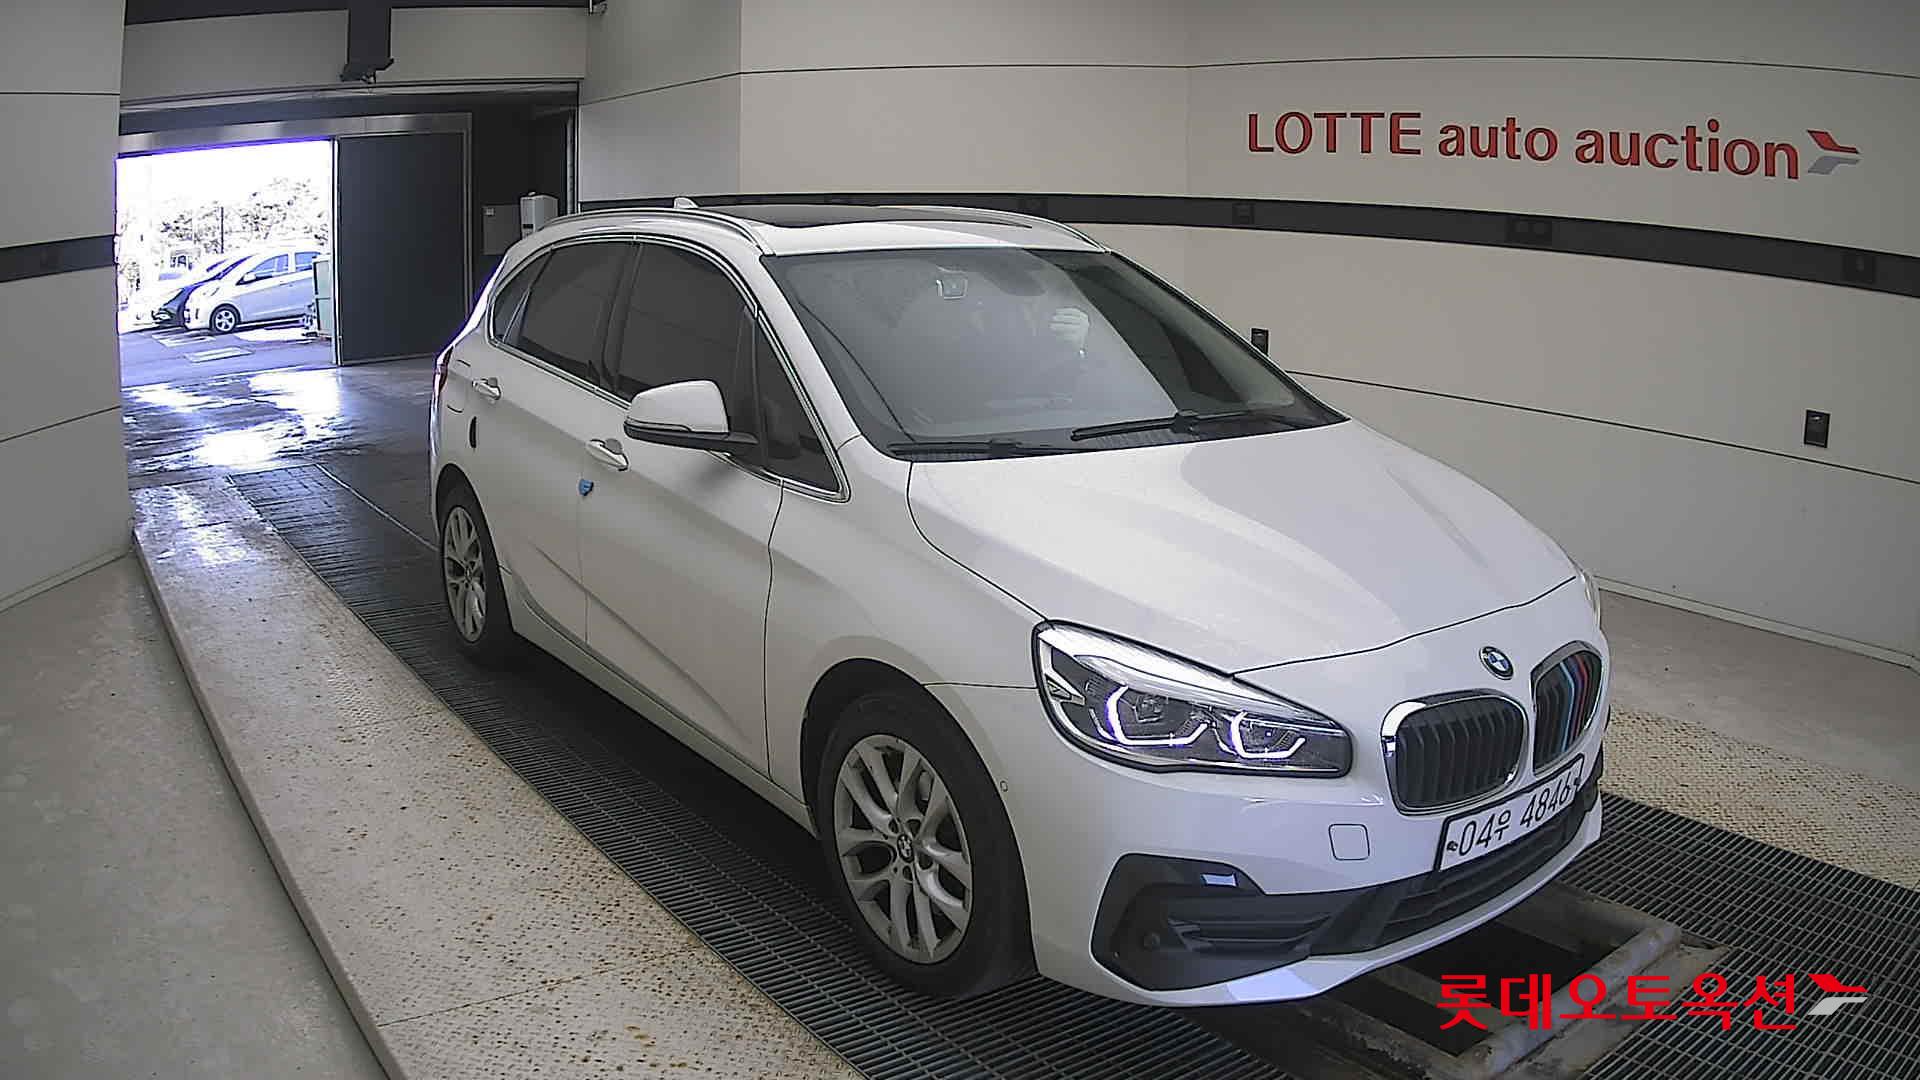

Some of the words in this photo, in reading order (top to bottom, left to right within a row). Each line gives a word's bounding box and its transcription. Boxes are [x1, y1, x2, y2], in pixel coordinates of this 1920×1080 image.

[1248, 111, 1422, 155] LOTTE
[1438, 117, 1559, 161] auto
[1575, 119, 1800, 180] auction
[1458, 809, 1511, 856] 04우
[1519, 771, 1572, 828] 4846
